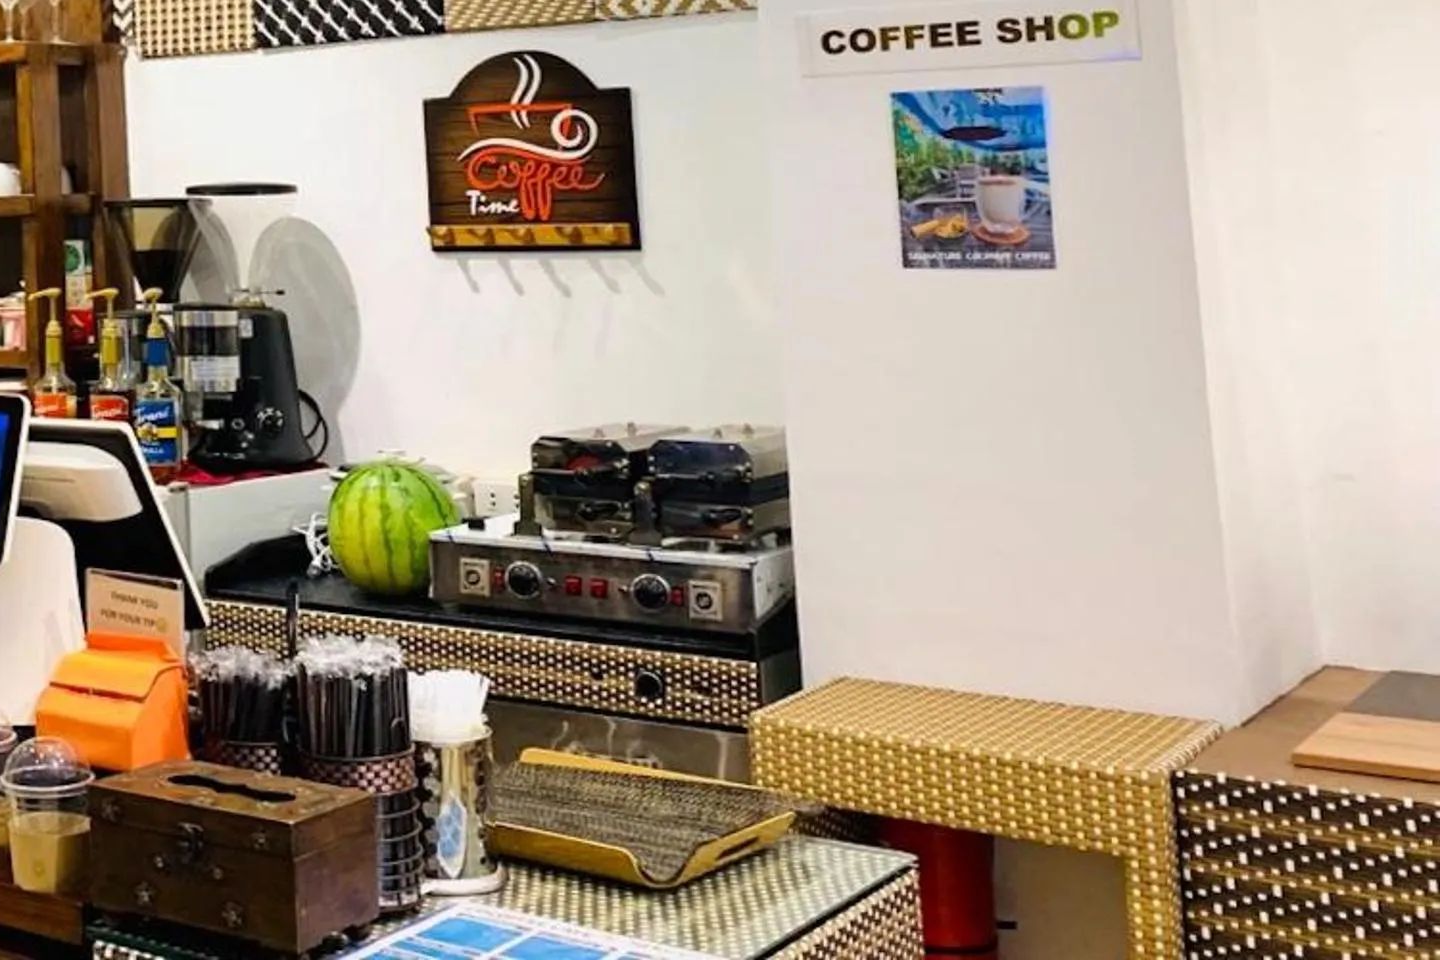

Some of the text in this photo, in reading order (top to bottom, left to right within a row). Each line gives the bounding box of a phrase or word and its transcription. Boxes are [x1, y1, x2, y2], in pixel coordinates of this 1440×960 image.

[820, 11, 1120, 55] COFFEE SHOP
[467, 147, 605, 221] Coffee
[466, 190, 520, 215] Time
[140, 598, 158, 610] YOU
